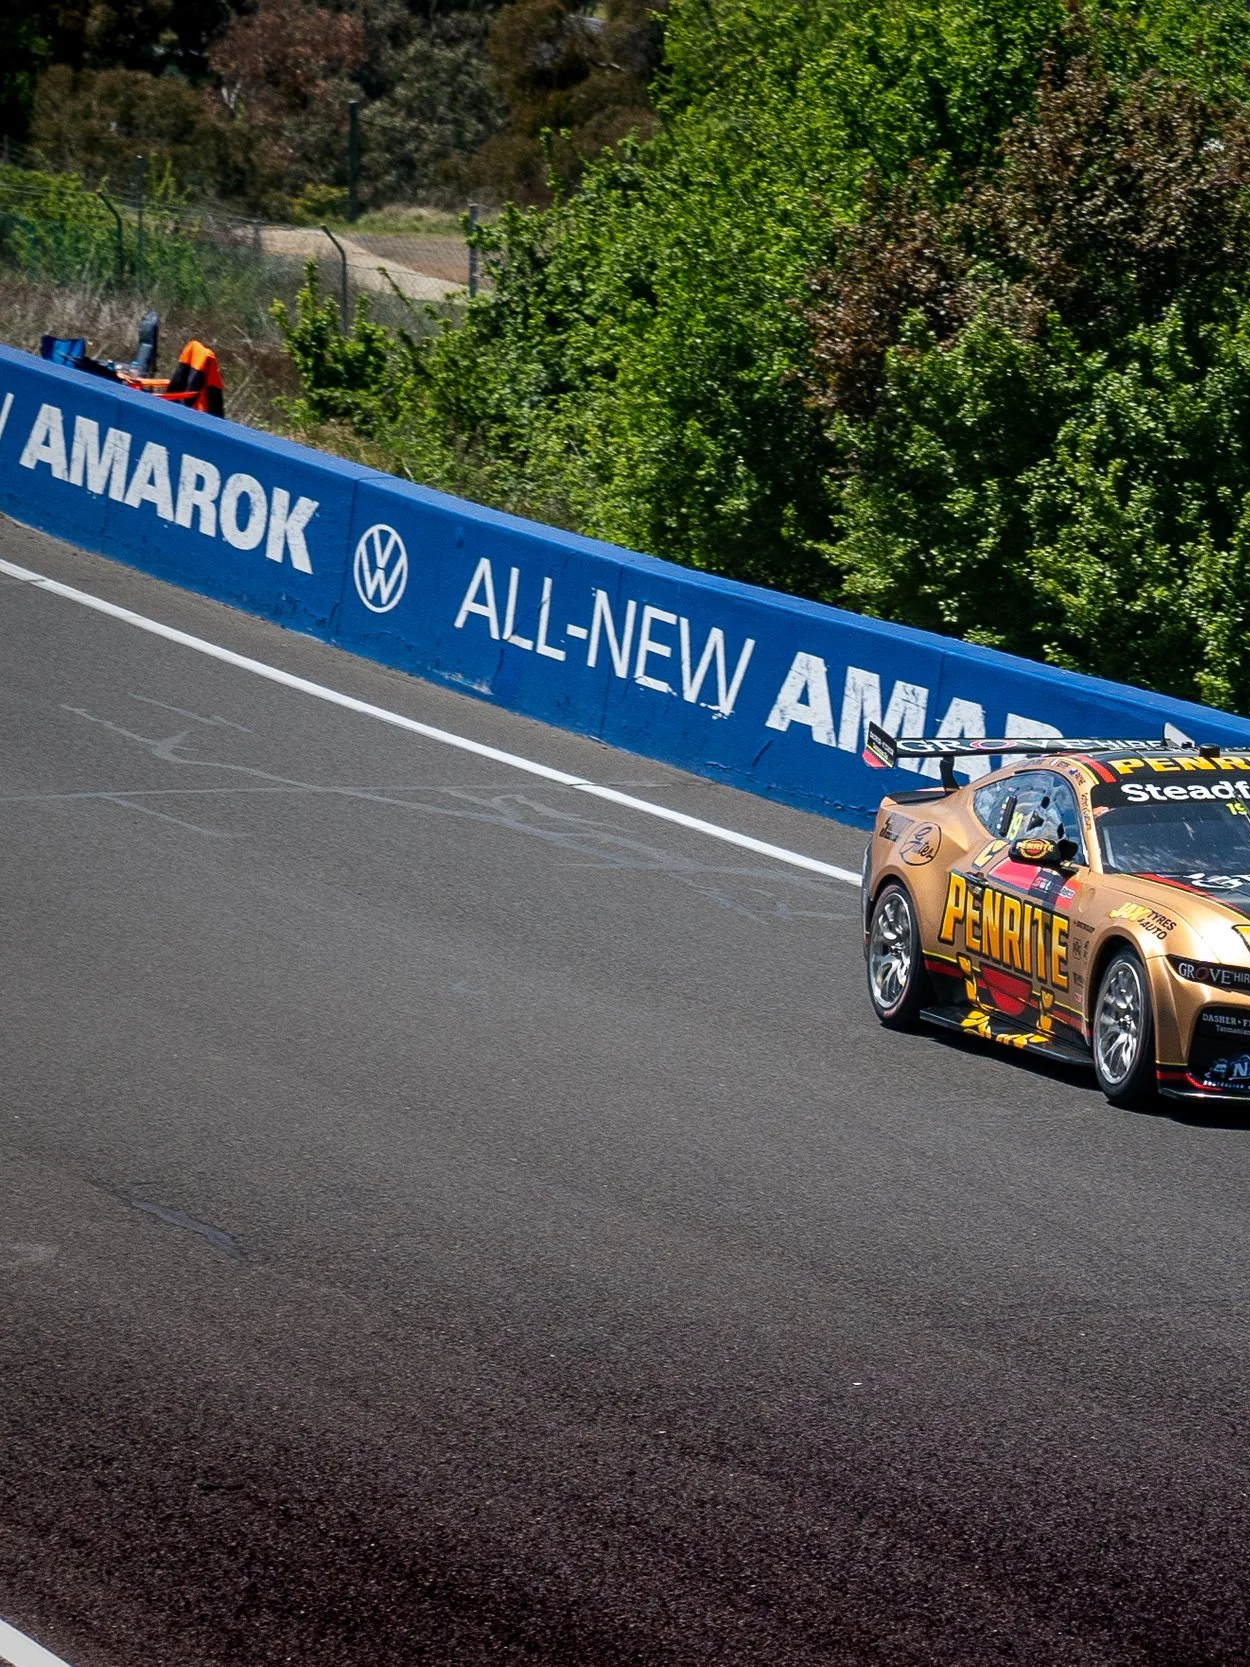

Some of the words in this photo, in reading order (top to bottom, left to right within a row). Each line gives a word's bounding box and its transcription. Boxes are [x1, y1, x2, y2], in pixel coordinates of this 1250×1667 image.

[19, 403, 319, 575] AMAROK
[454, 556, 756, 717] ALL-NEW
[1141, 920, 1168, 940] AUTO
[1147, 908, 1177, 931] TYRES
[938, 871, 1070, 992] PENRITE
[1178, 962, 1231, 985] GROVE
[1202, 1013, 1236, 1026] DASHER
[1216, 1025, 1250, 1037] Tasmanian
